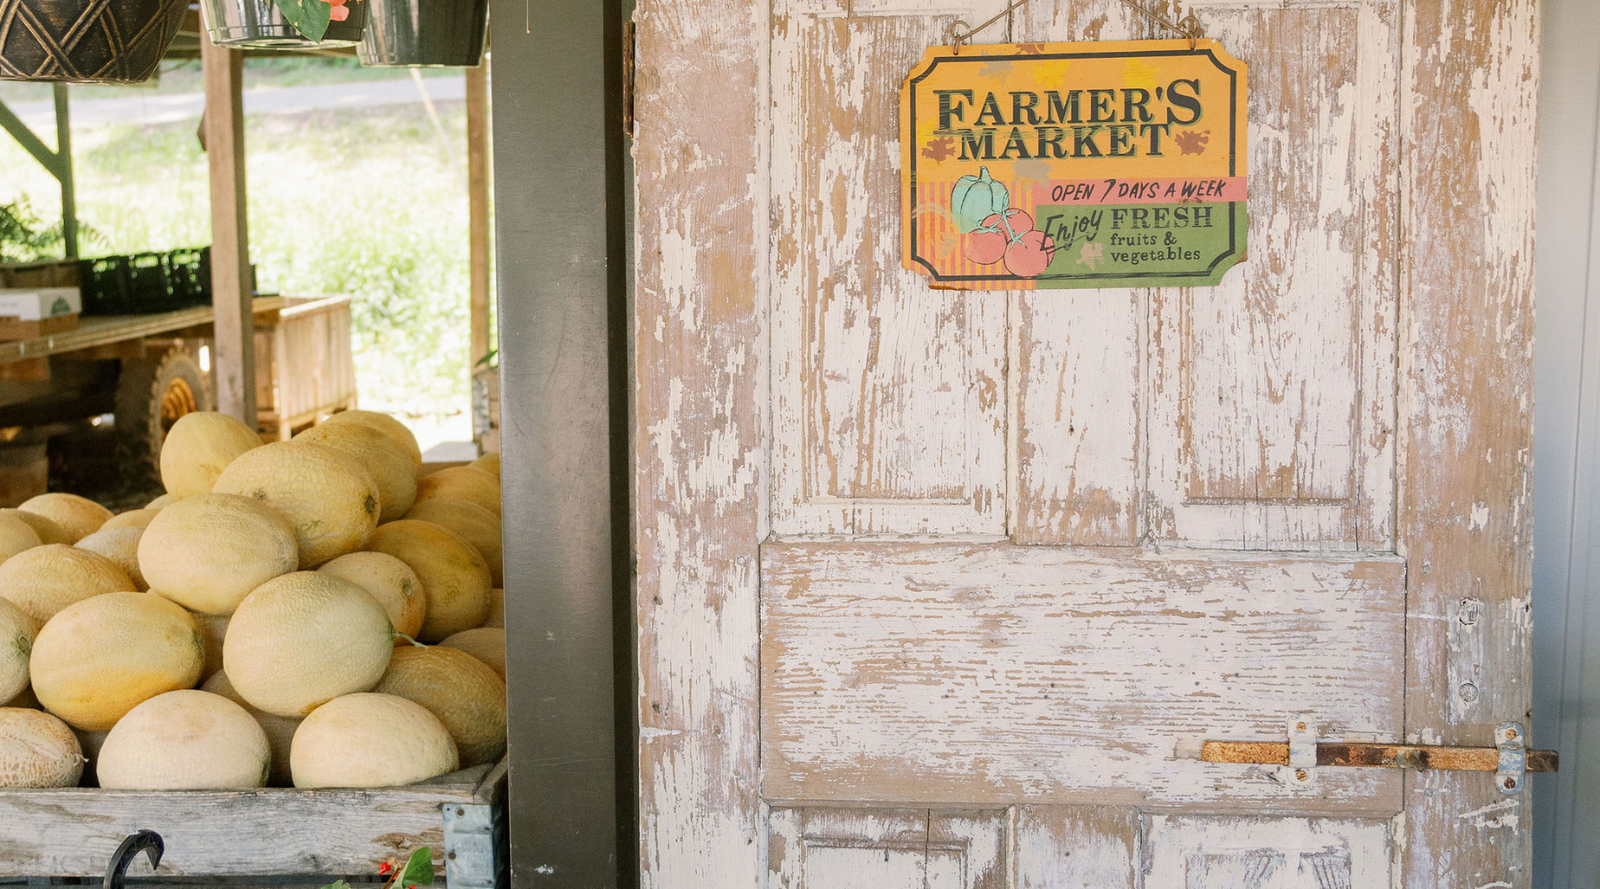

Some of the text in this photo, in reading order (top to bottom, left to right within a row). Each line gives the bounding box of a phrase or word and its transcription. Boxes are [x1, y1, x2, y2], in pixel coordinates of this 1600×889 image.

[933, 79, 1202, 136] FARMER'S
[957, 124, 1169, 160] MARKET
[1051, 179, 1226, 202] OPEN 7 DAYS A WEEK
[1040, 206, 1213, 252] Enjoy FRESH
[1110, 231, 1177, 246] fruits &
[1110, 247, 1200, 266] vegetables
